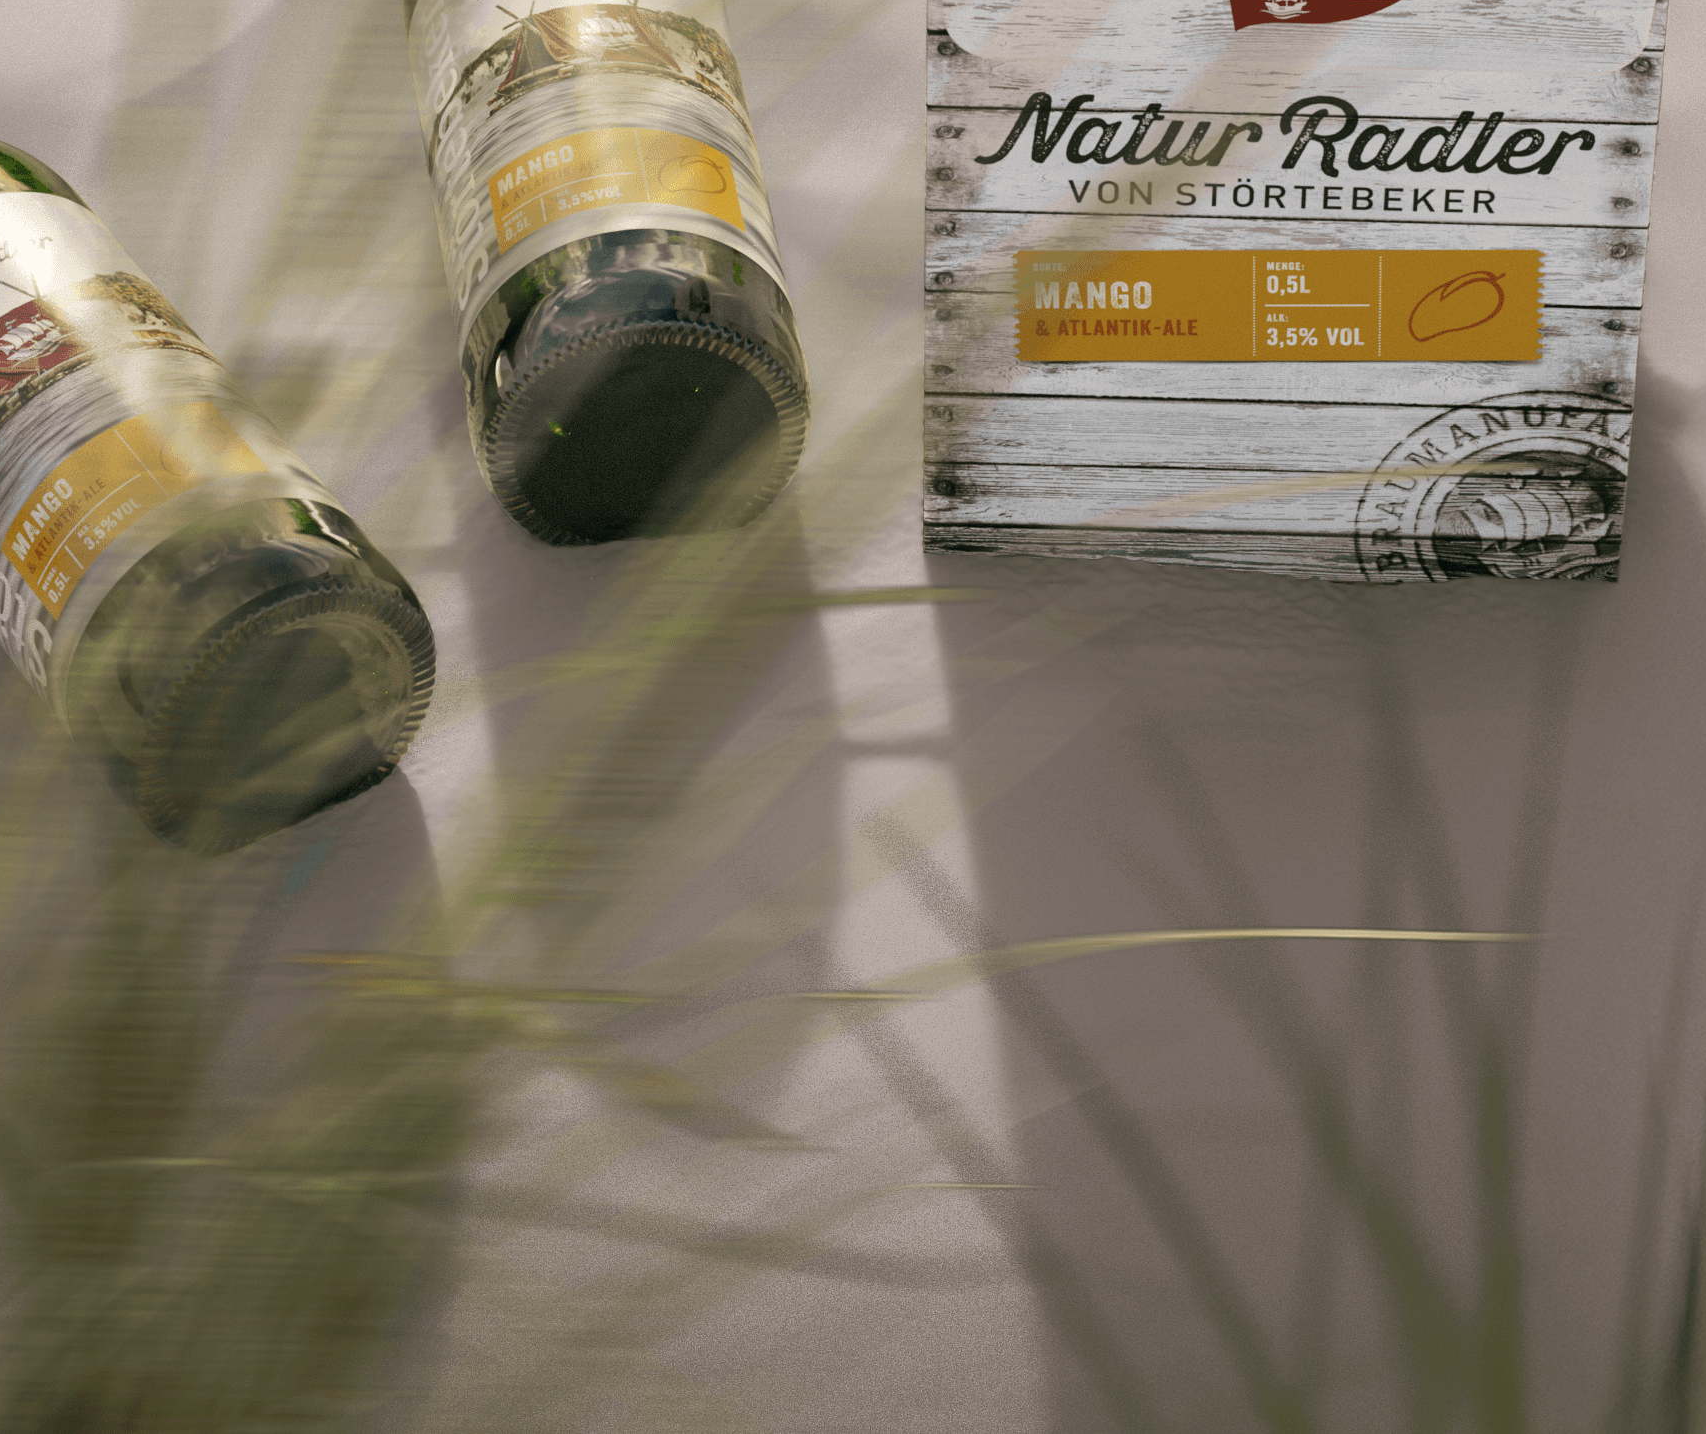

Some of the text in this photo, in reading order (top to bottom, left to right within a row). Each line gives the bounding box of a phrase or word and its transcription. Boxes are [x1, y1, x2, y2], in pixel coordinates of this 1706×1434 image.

[974, 91, 1597, 178] Natur Radler
[496, 145, 574, 198] MANGO
[1068, 178, 1496, 215] VON STÖRTEBEKER
[1266, 261, 1305, 271] MENGE:
[1034, 281, 1153, 310] MANGO
[1266, 275, 1311, 296] 0,5L
[1035, 318, 1199, 337] & ATLANTIK-ALE
[1266, 313, 1289, 323] ALK:
[1266, 327, 1365, 348] 3,5% VOL
[11, 478, 74, 561] MANGO
[48, 572, 70, 604] 0,5L
